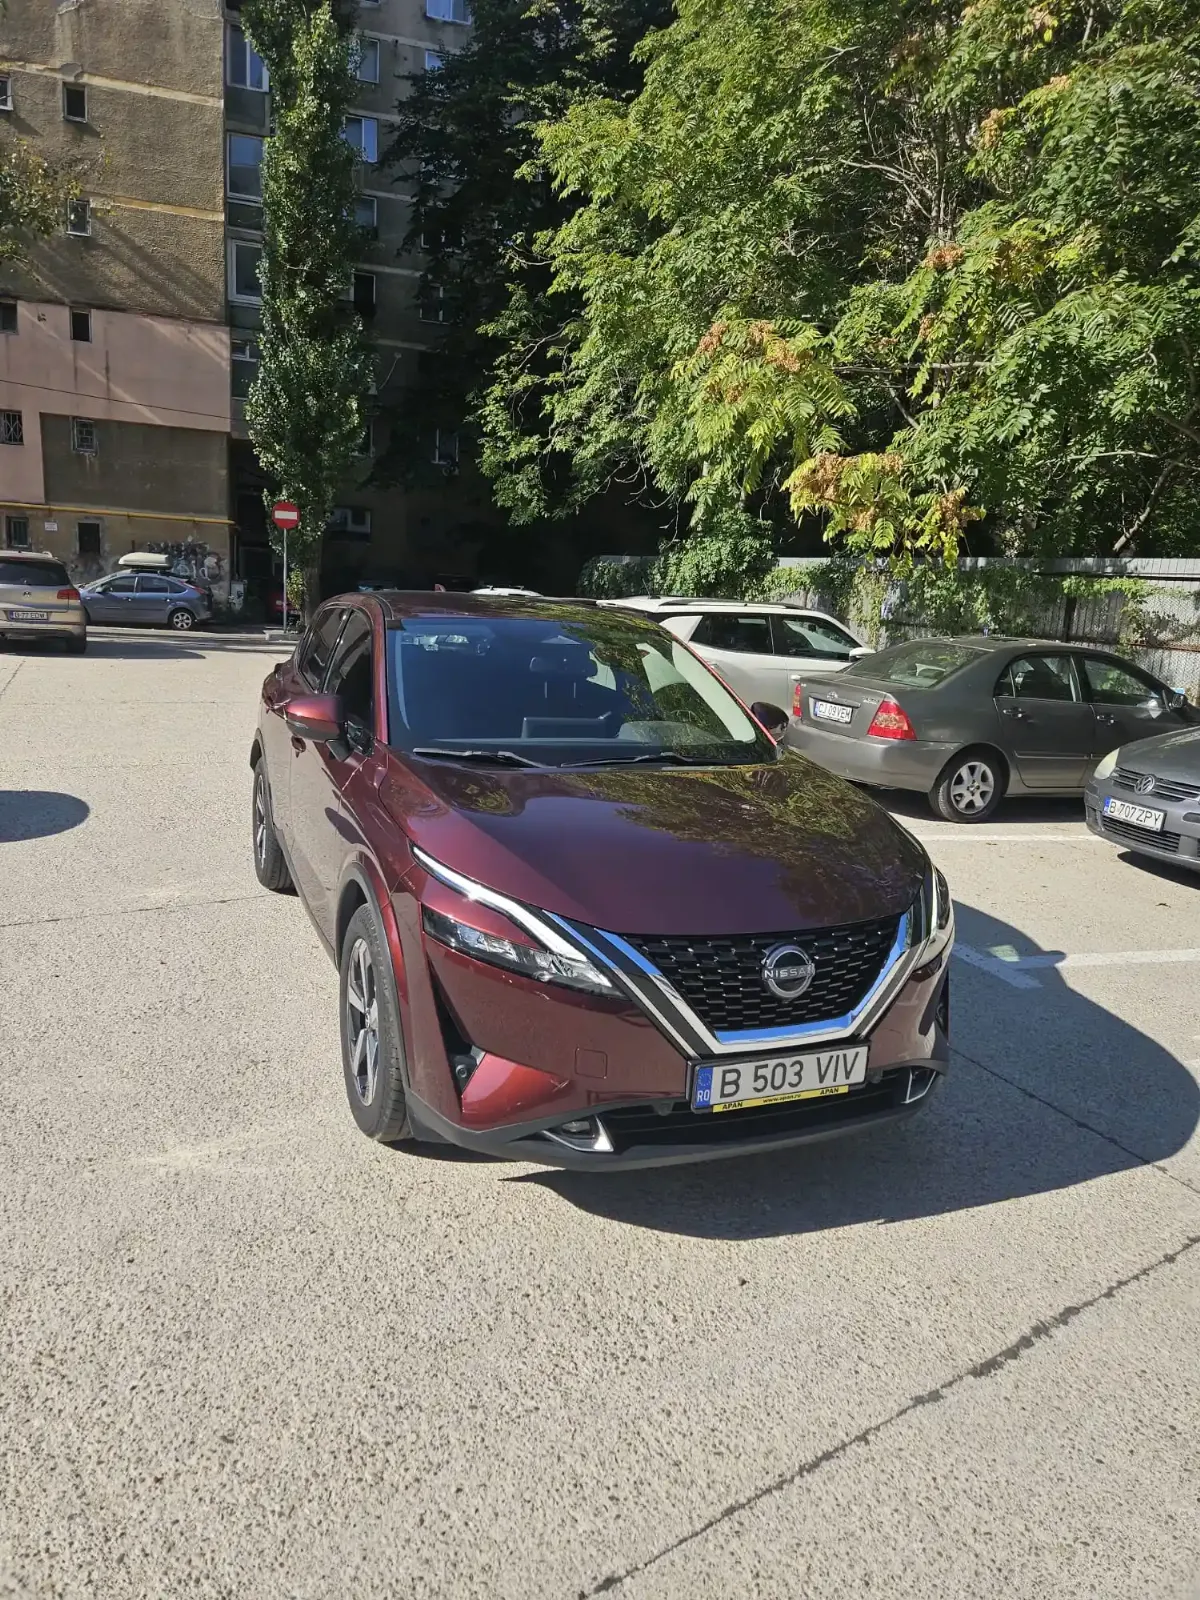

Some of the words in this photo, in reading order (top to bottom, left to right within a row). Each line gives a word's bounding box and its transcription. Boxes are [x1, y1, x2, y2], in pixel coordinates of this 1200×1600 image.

[1110, 801, 1116, 813] B
[1119, 804, 1136, 819] 707
[1136, 809, 1160, 825] ZPY
[720, 1068, 741, 1099] B
[752, 1060, 803, 1093] 503
[816, 1051, 859, 1084] VIV
[697, 1089, 710, 1102] RO
[722, 1101, 743, 1110] APAN
[820, 1087, 839, 1095] APAN
